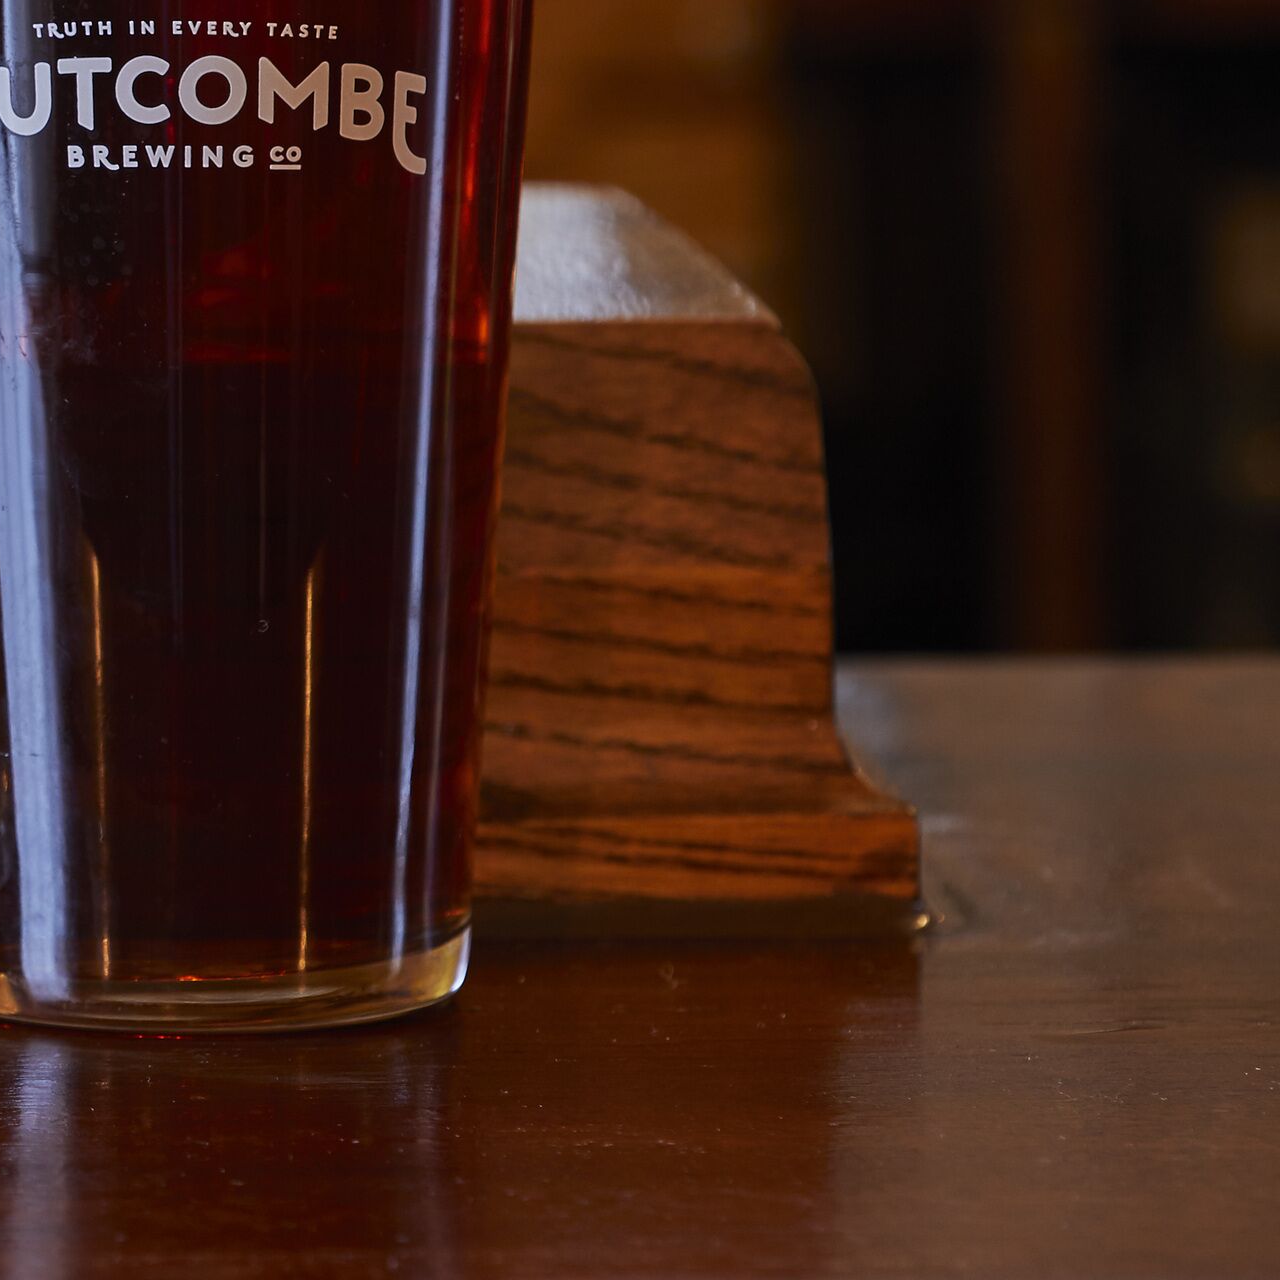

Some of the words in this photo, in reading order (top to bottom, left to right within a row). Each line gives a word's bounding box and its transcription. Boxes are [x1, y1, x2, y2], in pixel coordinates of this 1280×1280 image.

[32, 21, 113, 39] TRUTH
[128, 20, 155, 35] IN
[172, 20, 252, 38] EVERY
[266, 22, 339, 40] TASTE
[67, 145, 255, 171] BREWING
[269, 145, 302, 170] CO
